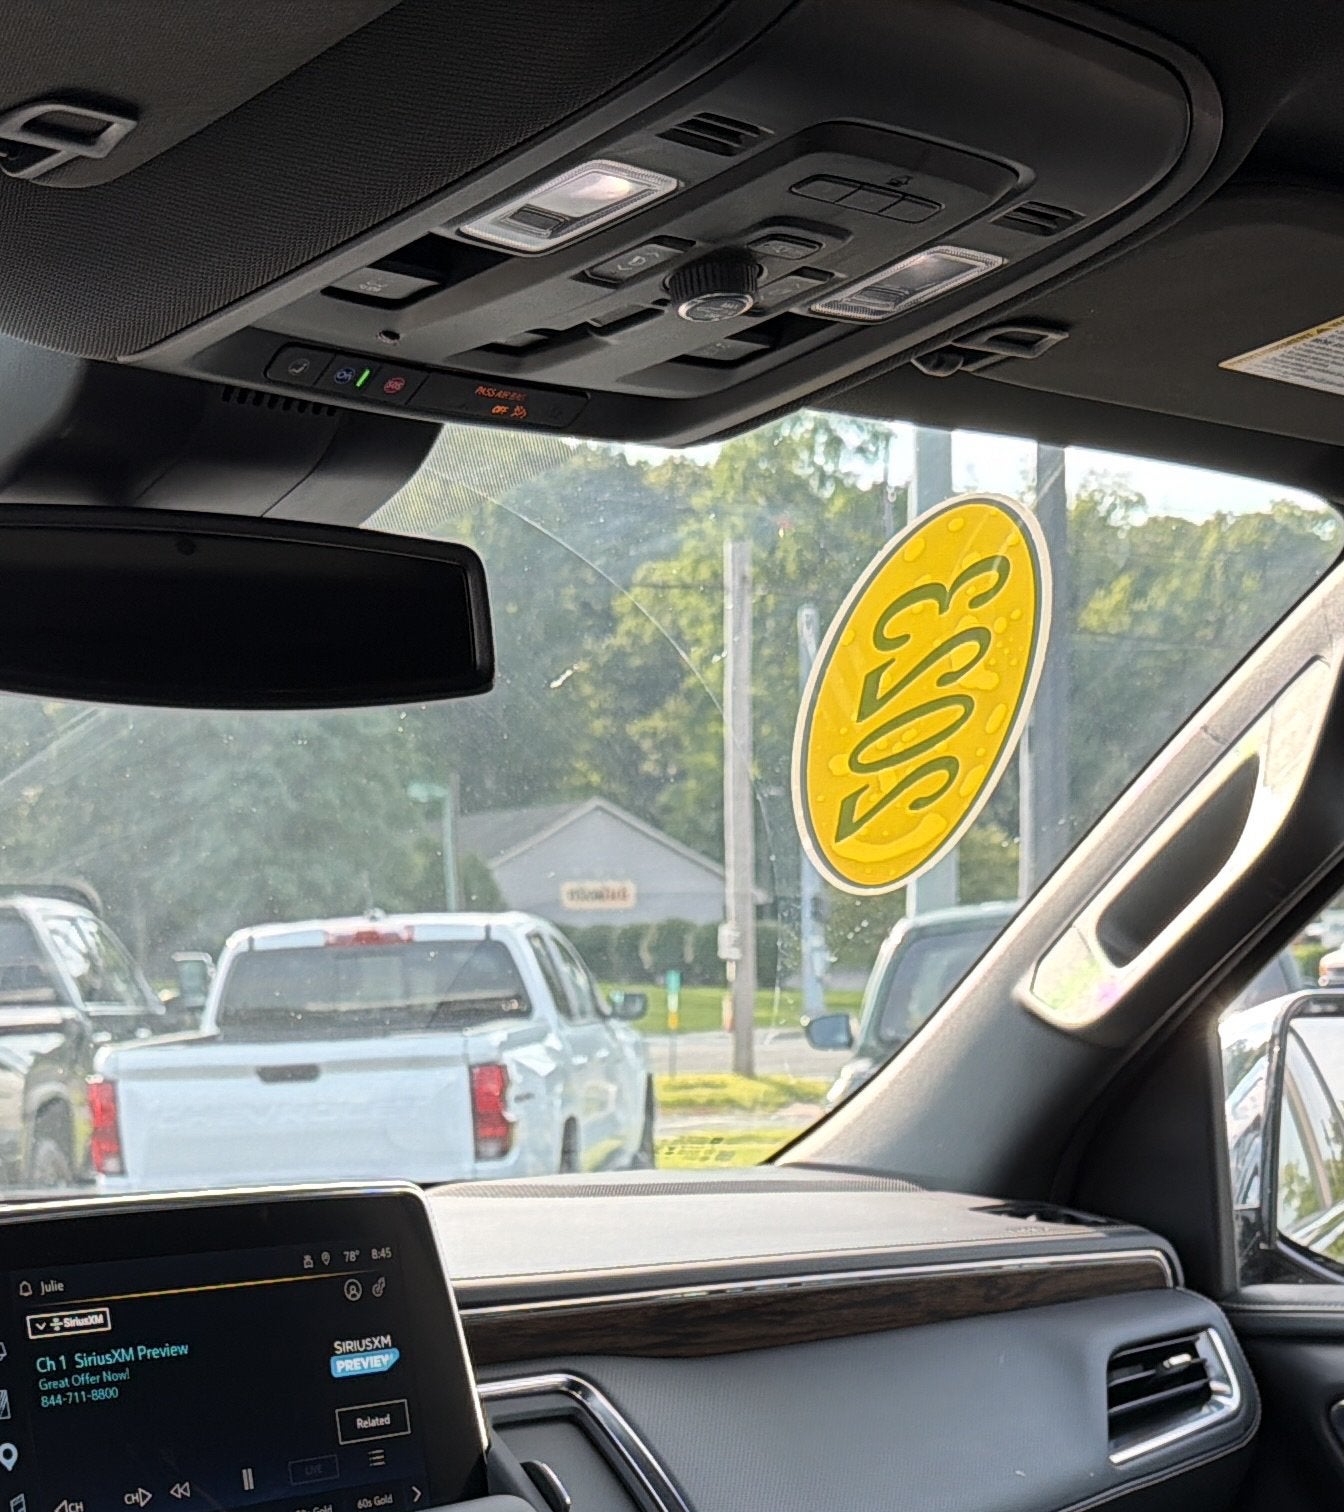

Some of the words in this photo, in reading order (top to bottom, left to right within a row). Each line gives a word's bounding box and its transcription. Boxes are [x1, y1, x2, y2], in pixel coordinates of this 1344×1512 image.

[371, 1247, 392, 1260] 8:45
[40, 1281, 65, 1296] Julie
[63, 1314, 105, 1329] SiriusXM
[334, 1334, 392, 1354] SIRIUSXM
[36, 1357, 57, 1374] Ch
[58, 1355, 67, 1371] 1
[74, 1346, 135, 1370] SiriusXM
[137, 1342, 189, 1361] Preview
[336, 1354, 394, 1373] PREVIEW
[38, 1377, 70, 1391] Great
[71, 1371, 101, 1387] Offer
[103, 1367, 130, 1382] Now!
[40, 1386, 119, 1409] 844-711-8800
[356, 1413, 391, 1429] Related
[124, 1492, 139, 1505] CH
[357, 1498, 373, 1509] 60s
[373, 1493, 394, 1506] Gold
